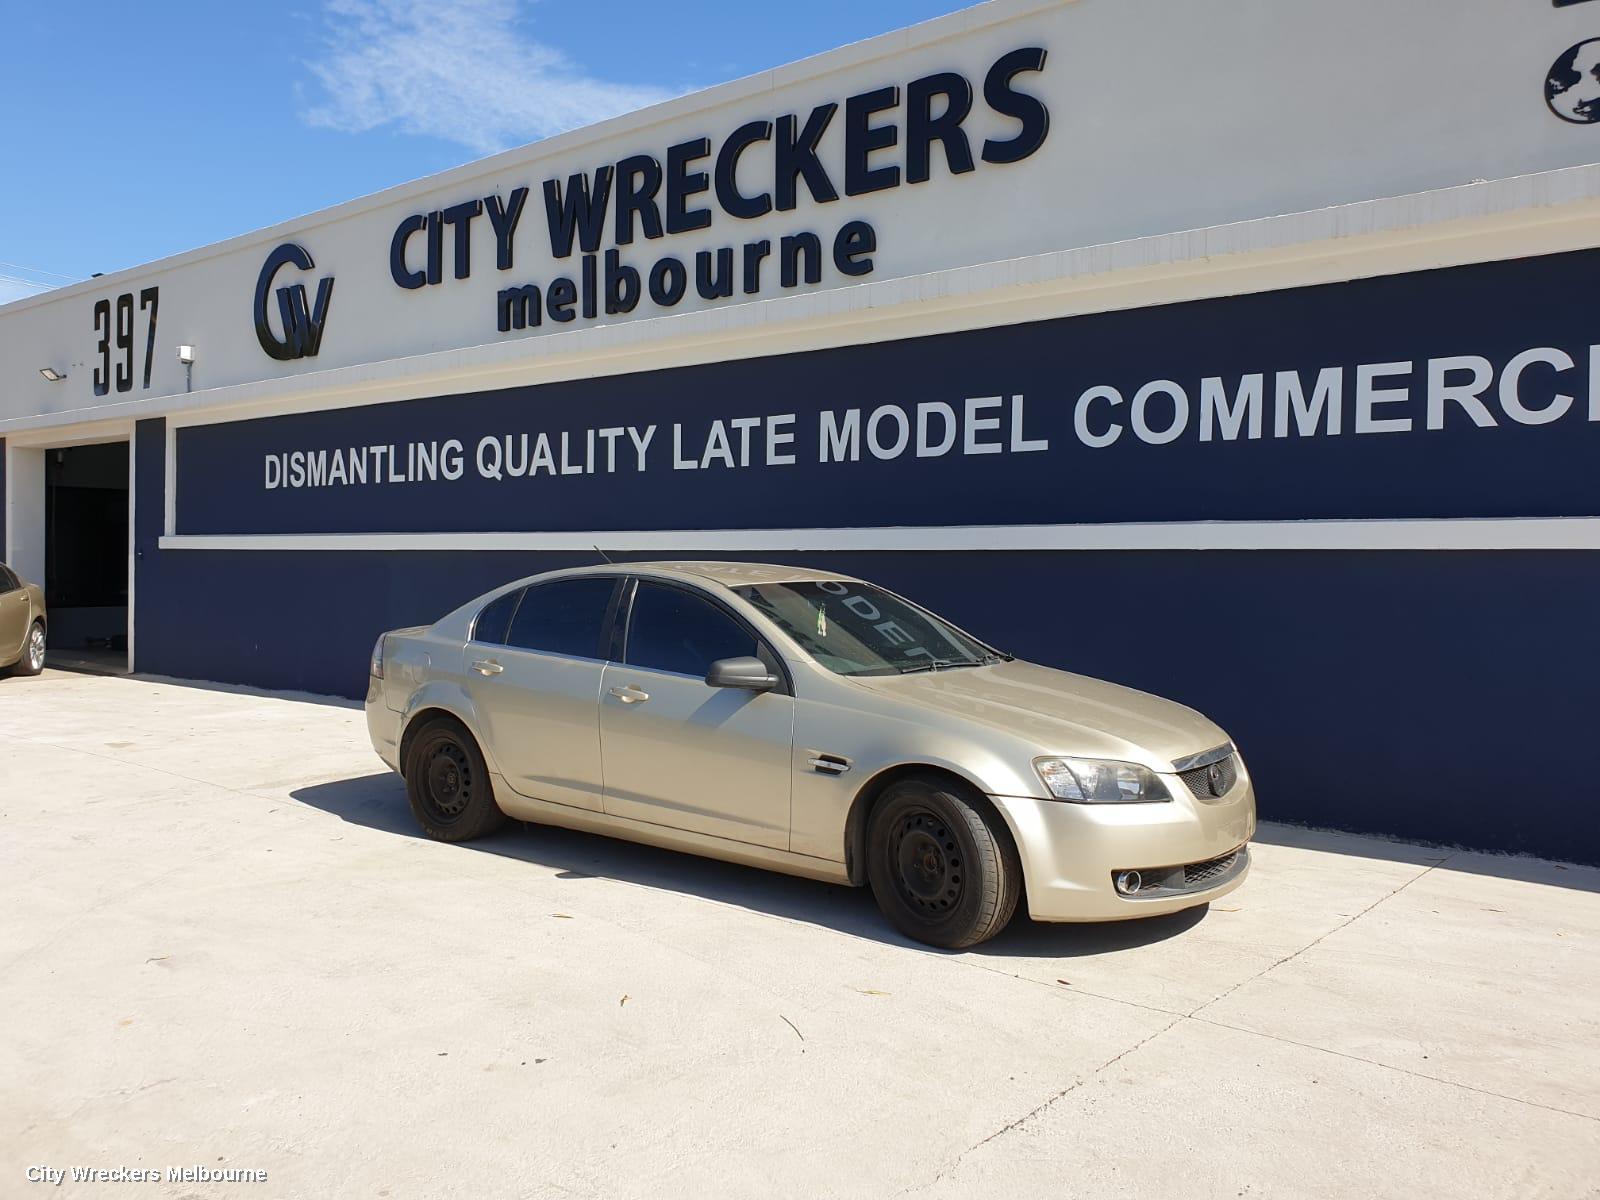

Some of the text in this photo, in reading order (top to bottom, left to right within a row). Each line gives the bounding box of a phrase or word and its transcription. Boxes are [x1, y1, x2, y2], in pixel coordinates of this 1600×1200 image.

[390, 47, 1050, 289] CITY WRECKERS
[497, 220, 877, 332] melbourne
[93, 286, 160, 396] 397
[264, 439, 465, 490] DISMANTLING
[476, 425, 657, 481] QUALITY
[673, 413, 797, 471] LATE
[819, 394, 1049, 464] MODEL
